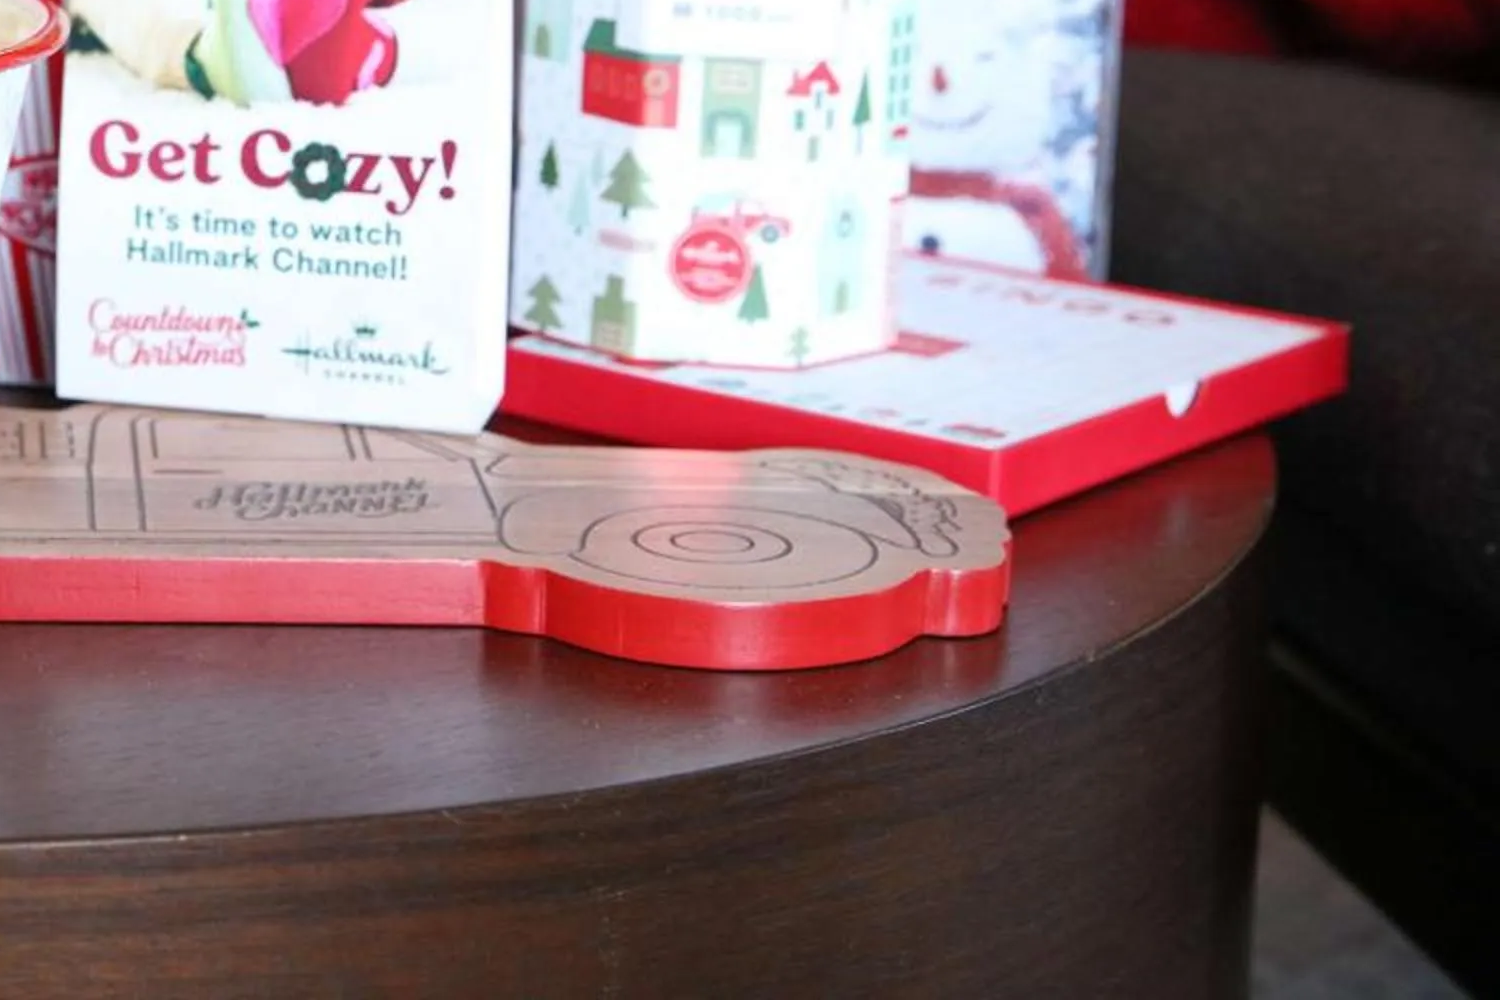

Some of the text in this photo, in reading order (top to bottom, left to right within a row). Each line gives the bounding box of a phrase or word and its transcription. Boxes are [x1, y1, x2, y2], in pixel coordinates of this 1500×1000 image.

[88, 118, 458, 215] Get Cozy!
[133, 205, 403, 247] It's time to watch
[125, 237, 409, 281] Hallmark Channel!
[88, 297, 248, 333] Countdown
[108, 332, 246, 368] Christmas
[280, 330, 451, 376] Hallmark
